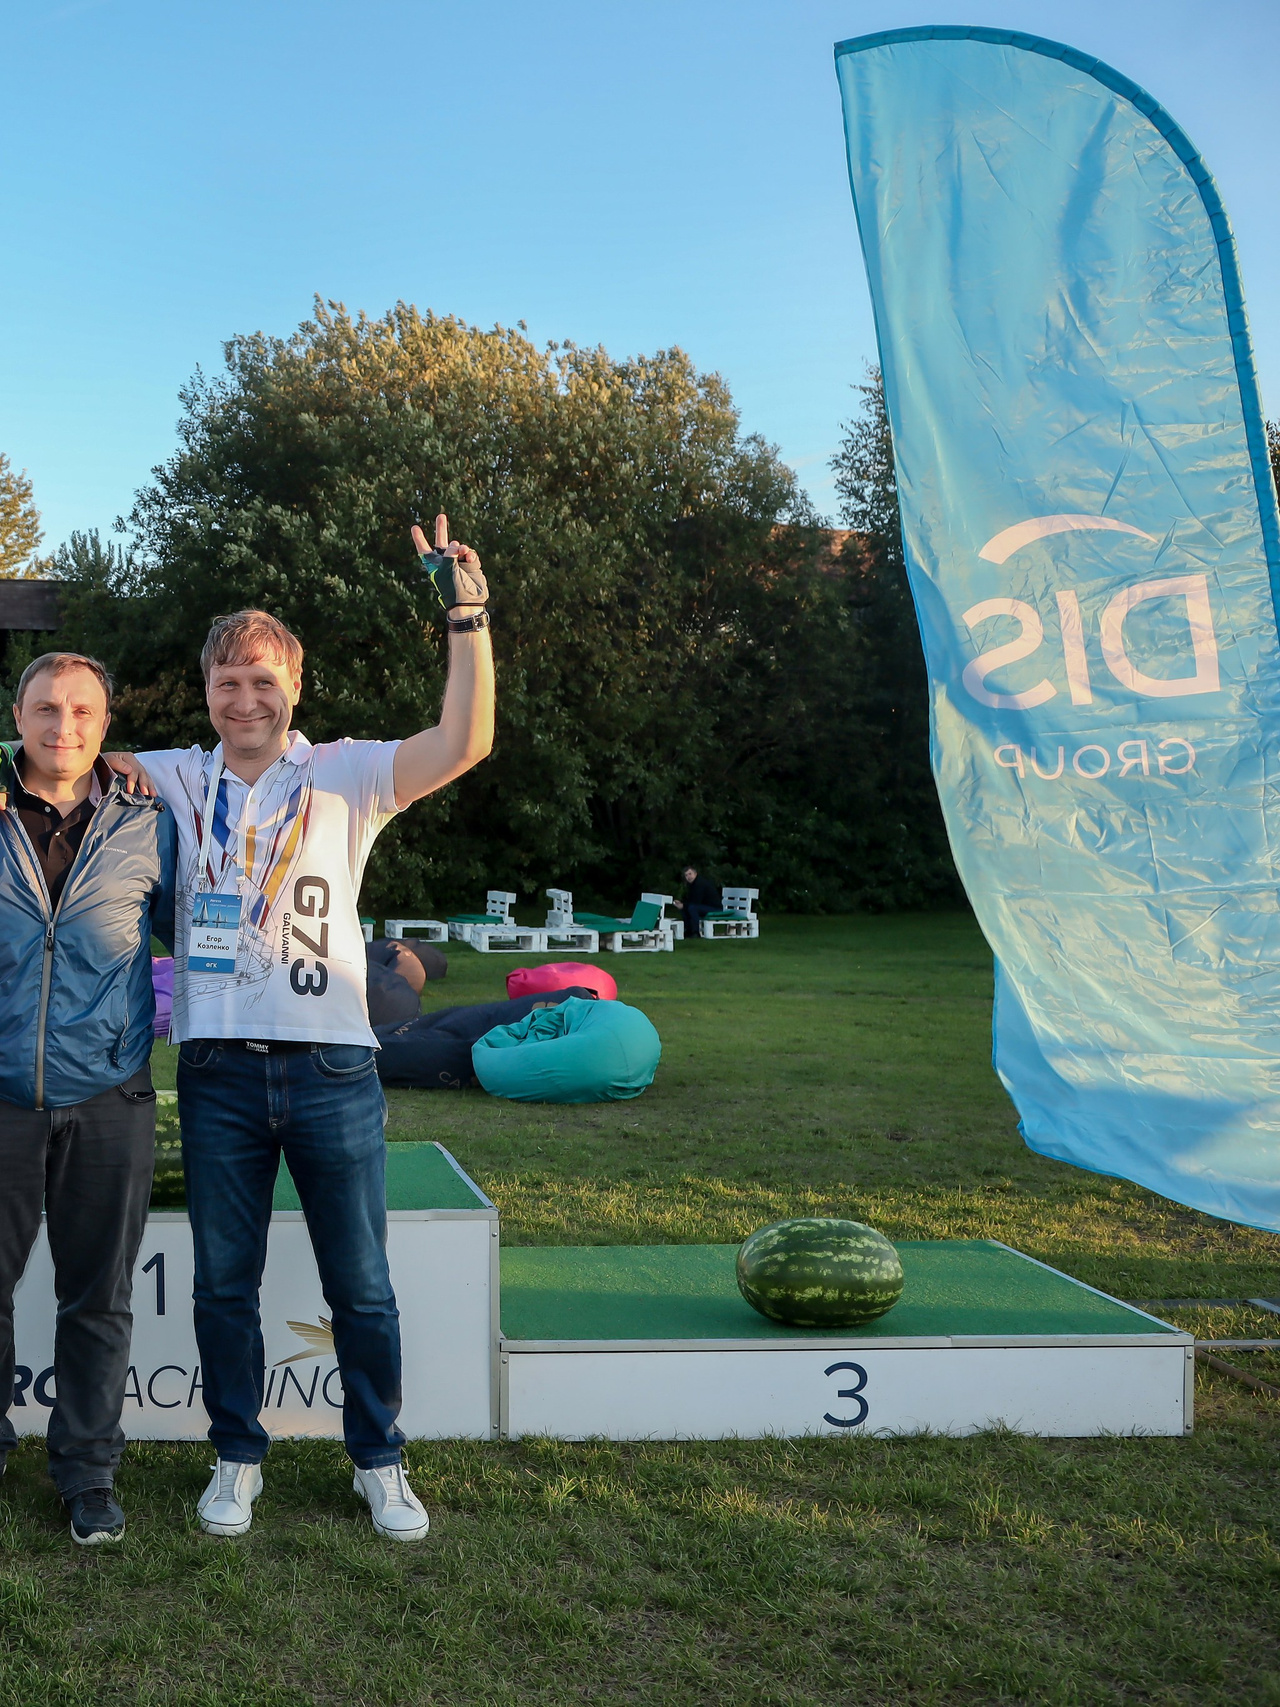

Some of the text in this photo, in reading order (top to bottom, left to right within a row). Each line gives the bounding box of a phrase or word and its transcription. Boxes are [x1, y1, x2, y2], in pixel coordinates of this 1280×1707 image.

[197, 942, 230, 951] Козленко
[206, 935, 223, 943] Егор
[280, 912, 292, 965] GALVANNI
[289, 875, 330, 997] G73
[245, 1041, 269, 1050] TOMMY
[141, 1253, 166, 1316] 1
[823, 1362, 869, 1427] 3
